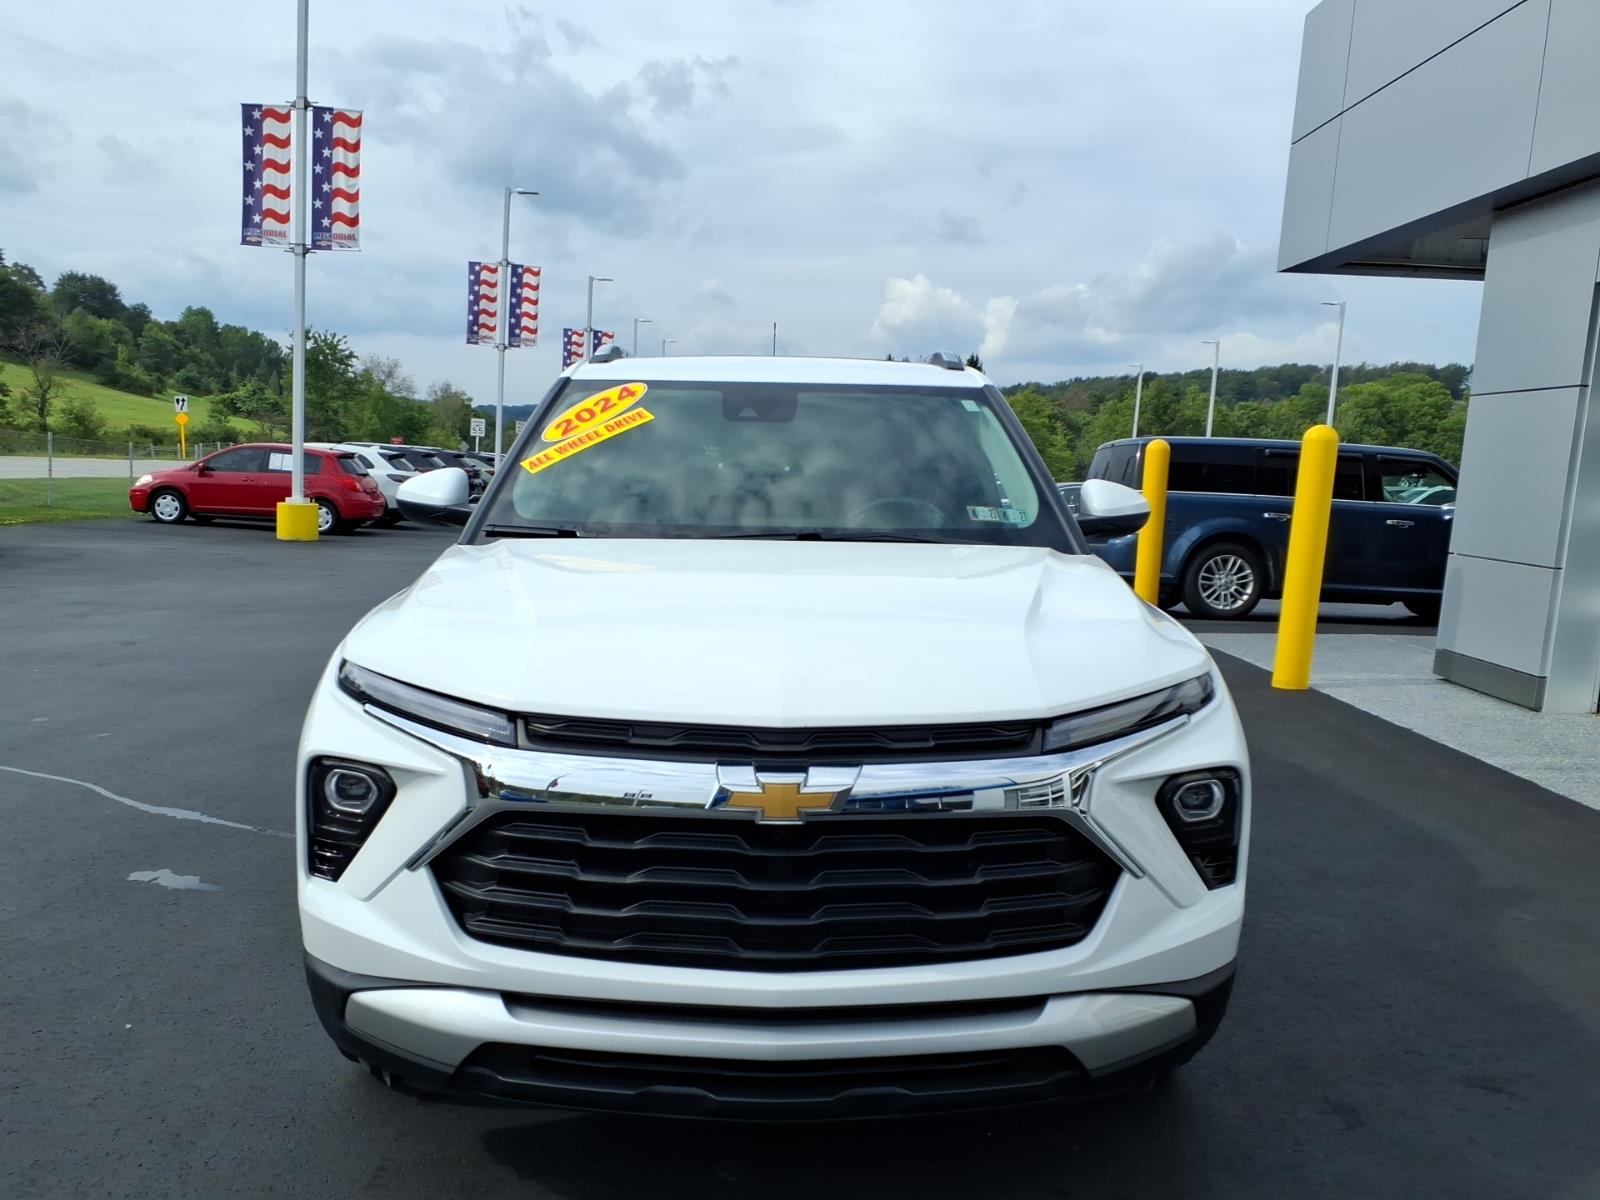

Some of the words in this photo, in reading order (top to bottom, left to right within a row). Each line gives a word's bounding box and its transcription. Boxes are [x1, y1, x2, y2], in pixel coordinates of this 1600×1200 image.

[554, 386, 638, 437] 2024
[528, 453, 555, 470] ALL
[554, 430, 606, 455] WHEEL
[604, 411, 648, 433] DRIVE
